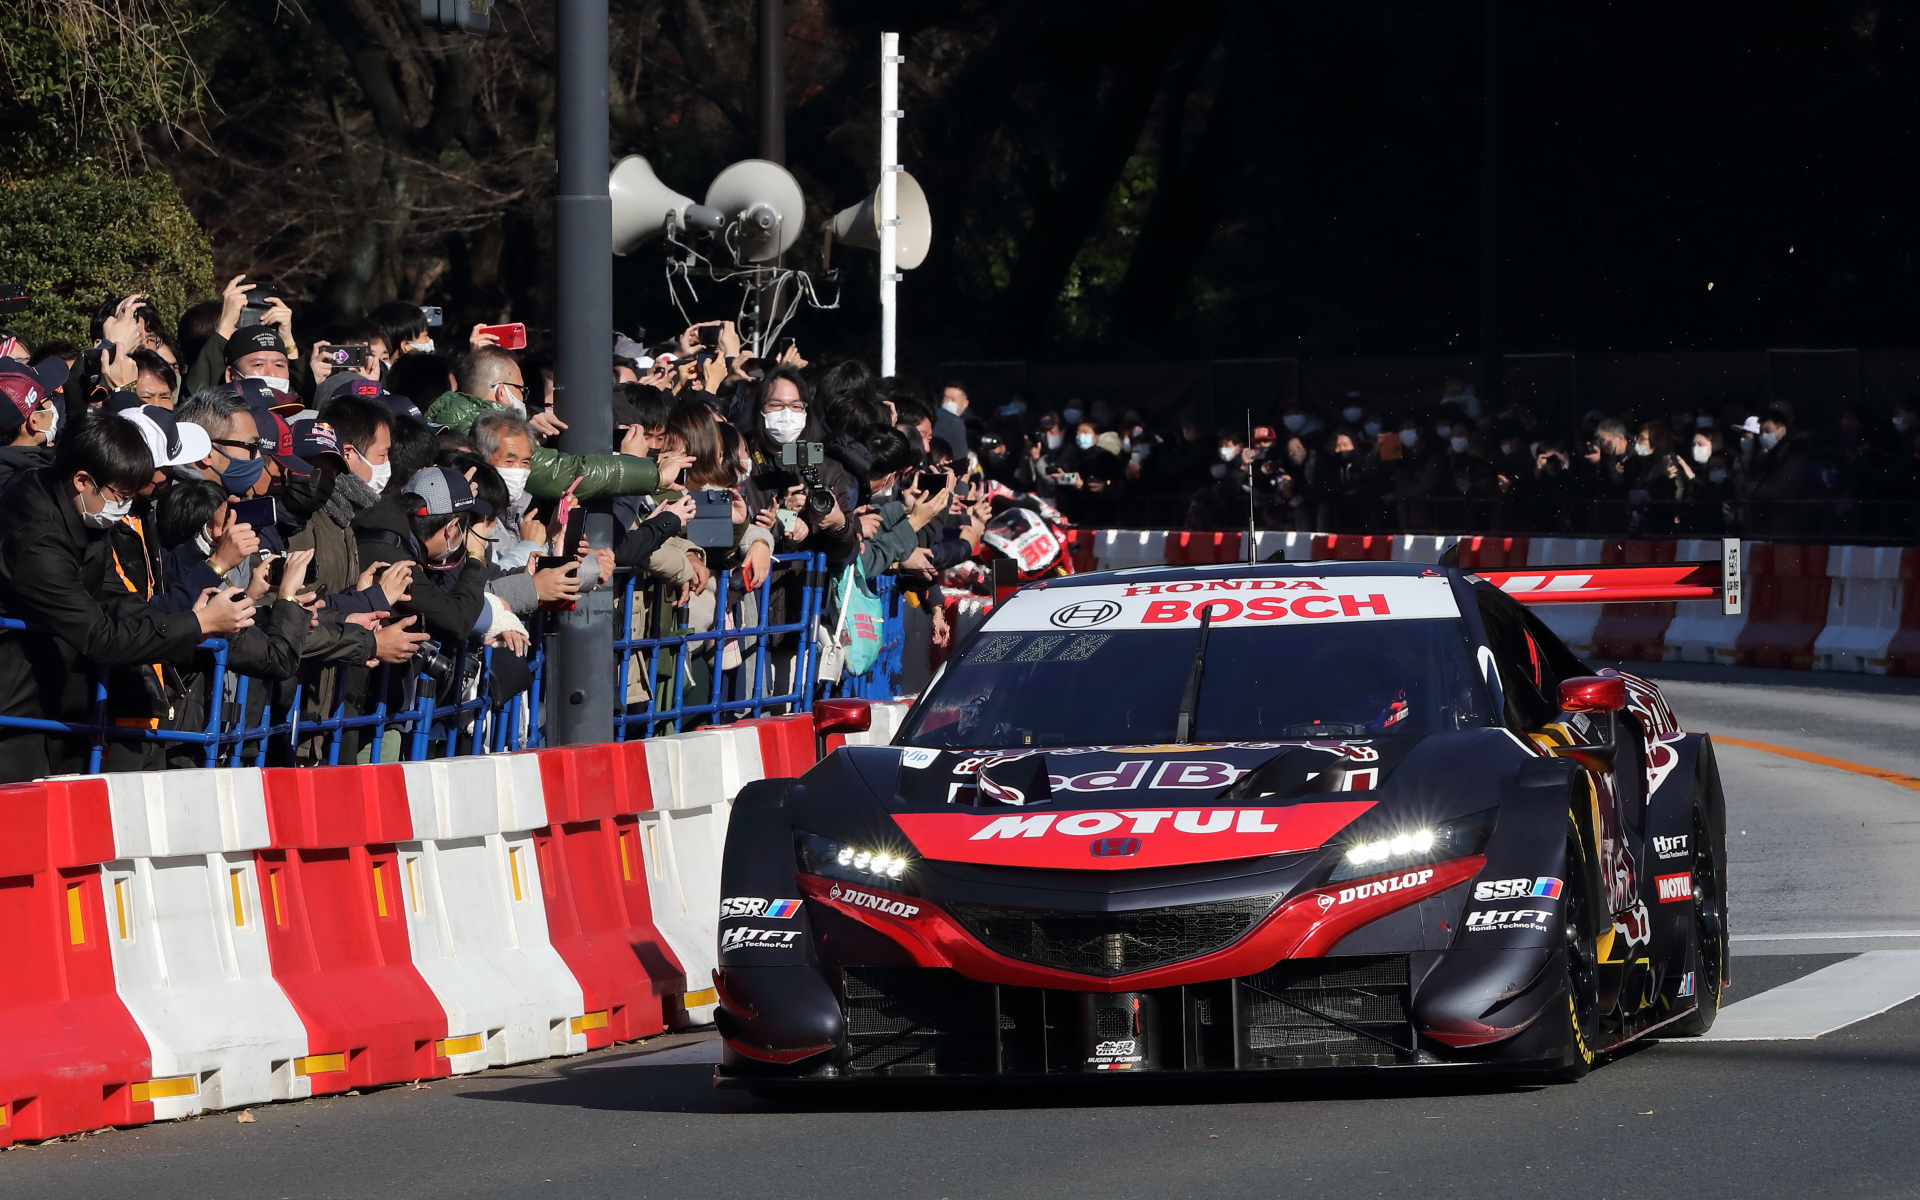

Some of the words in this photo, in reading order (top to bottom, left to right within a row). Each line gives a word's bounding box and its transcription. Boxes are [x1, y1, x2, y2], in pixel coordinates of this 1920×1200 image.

[25, 386, 38, 408] 16
[357, 386, 378, 396] 33
[1018, 534, 1054, 567] 30
[1121, 580, 1328, 597] HONDA
[1141, 594, 1391, 624] BOSCH
[968, 810, 1279, 840] MOTUL
[1652, 835, 1688, 853] HTFT
[1338, 869, 1434, 904] DUNLOP
[1474, 878, 1532, 901] SSR
[1658, 876, 1692, 899] MOTUL
[720, 896, 768, 919] SSR
[841, 889, 920, 918] DUNLOP
[1465, 910, 1553, 926] HTFT
[721, 926, 802, 947] HTFT
[722, 942, 743, 954] Honda
[1115, 1055, 1142, 1063] POWER
